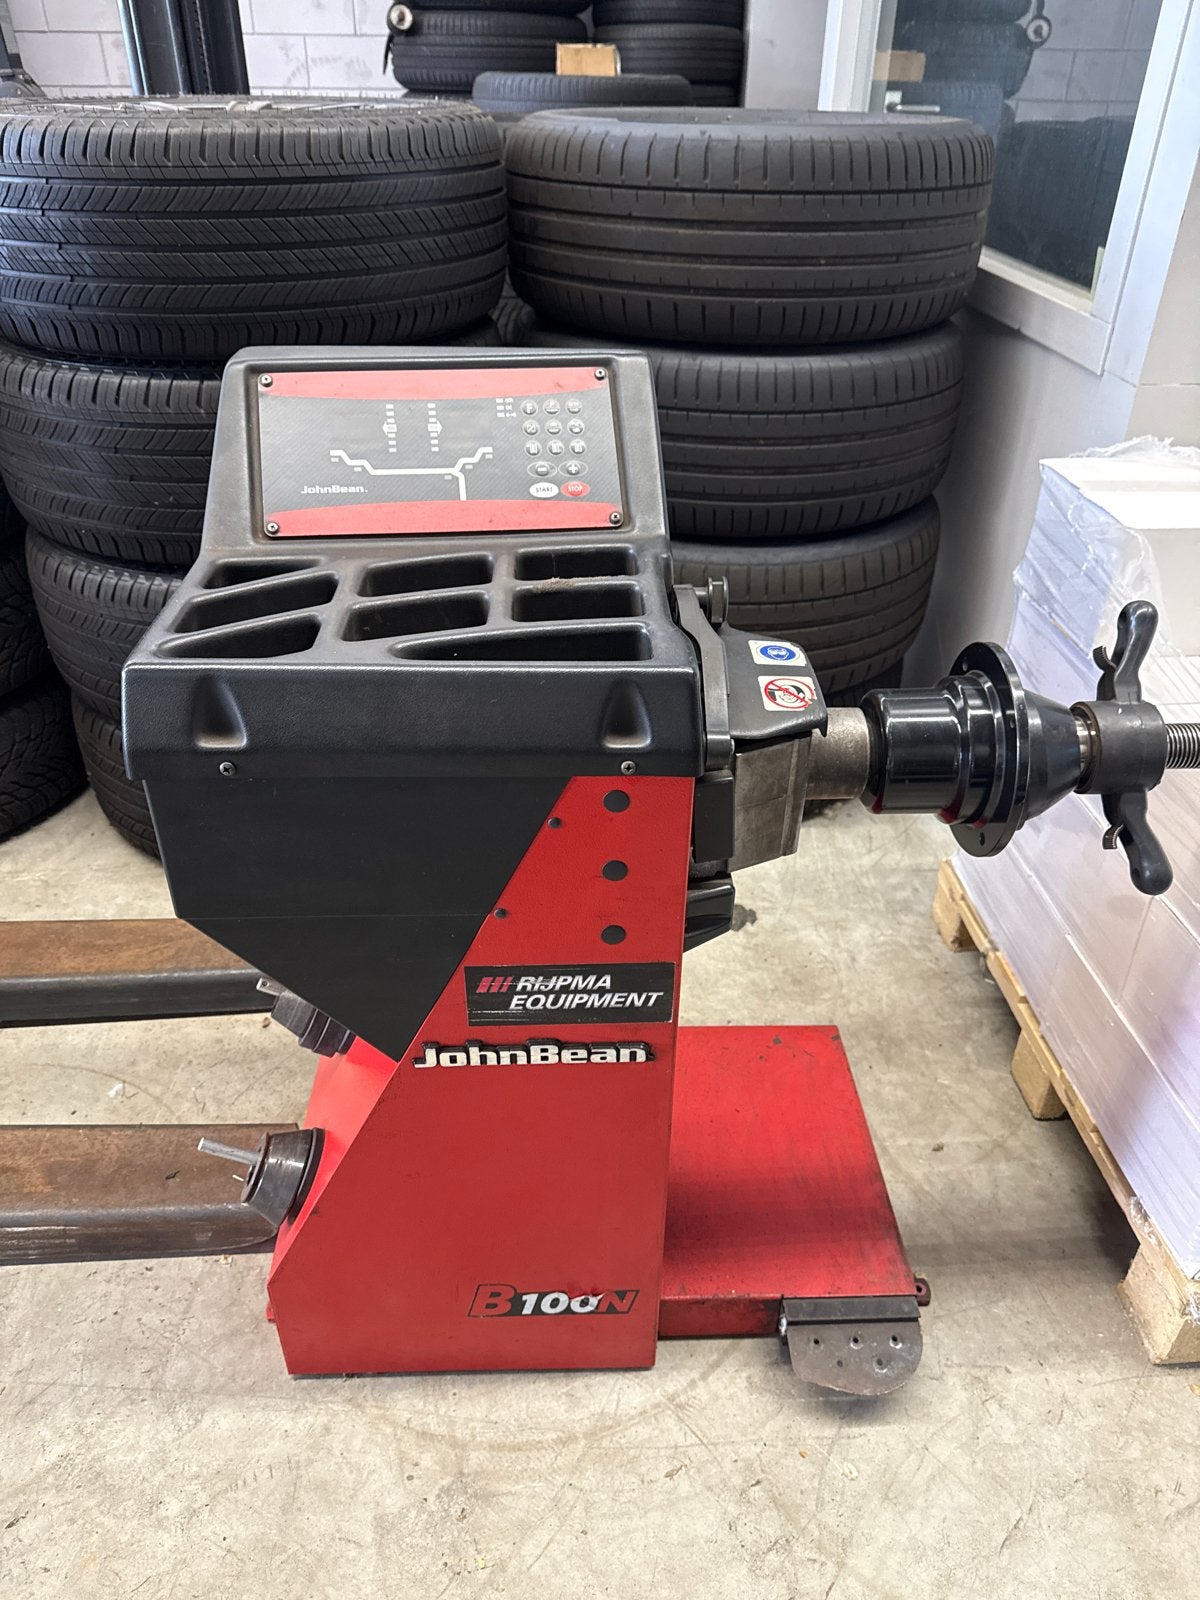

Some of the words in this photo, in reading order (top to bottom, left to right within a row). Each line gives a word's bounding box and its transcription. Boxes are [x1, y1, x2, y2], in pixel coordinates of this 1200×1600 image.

[567, 485, 583, 493] STOP
[515, 973, 612, 992] RIJPMA
[509, 991, 663, 1011] EQUIPMENT
[468, 1284, 639, 1317] B100N
